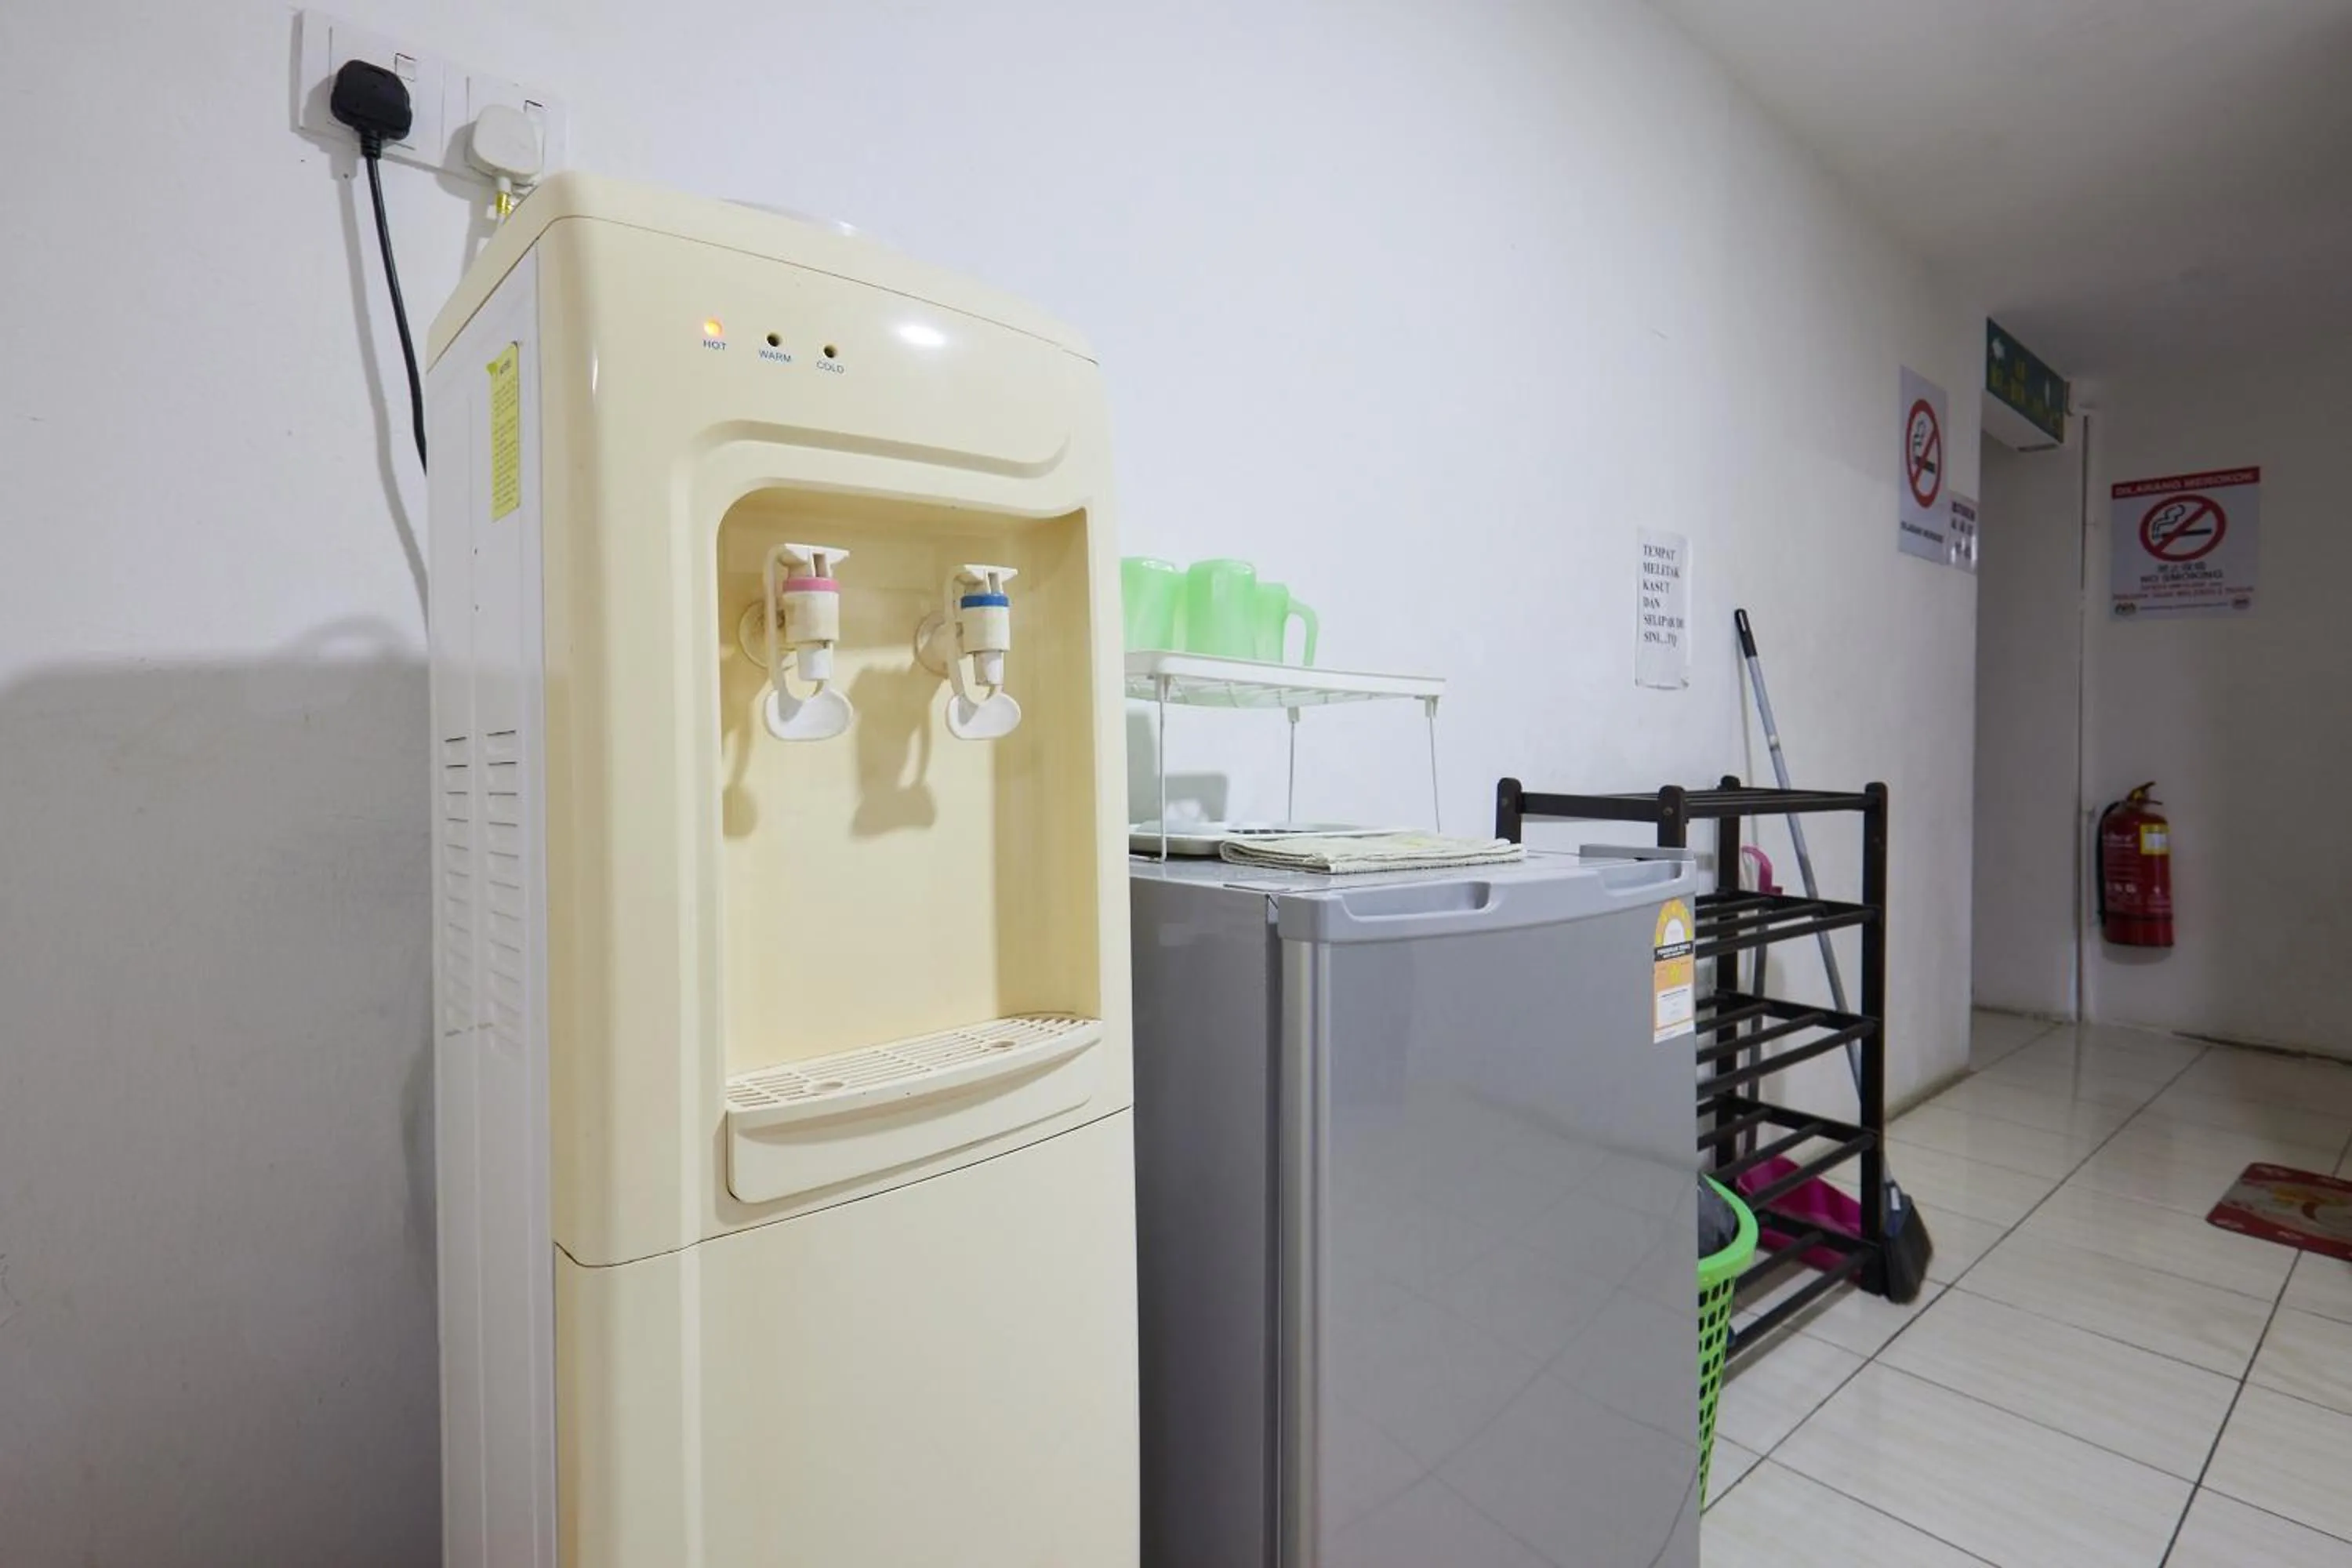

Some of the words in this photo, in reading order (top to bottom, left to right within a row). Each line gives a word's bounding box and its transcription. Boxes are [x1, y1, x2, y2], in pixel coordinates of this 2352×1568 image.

[702, 339, 727, 351] HOT
[758, 349, 792, 363] WARM
[816, 360, 845, 375] COLD
[1642, 543, 1676, 561] TEMPAT
[1642, 579, 1670, 593] KASUT
[1642, 596, 1661, 609] DAN
